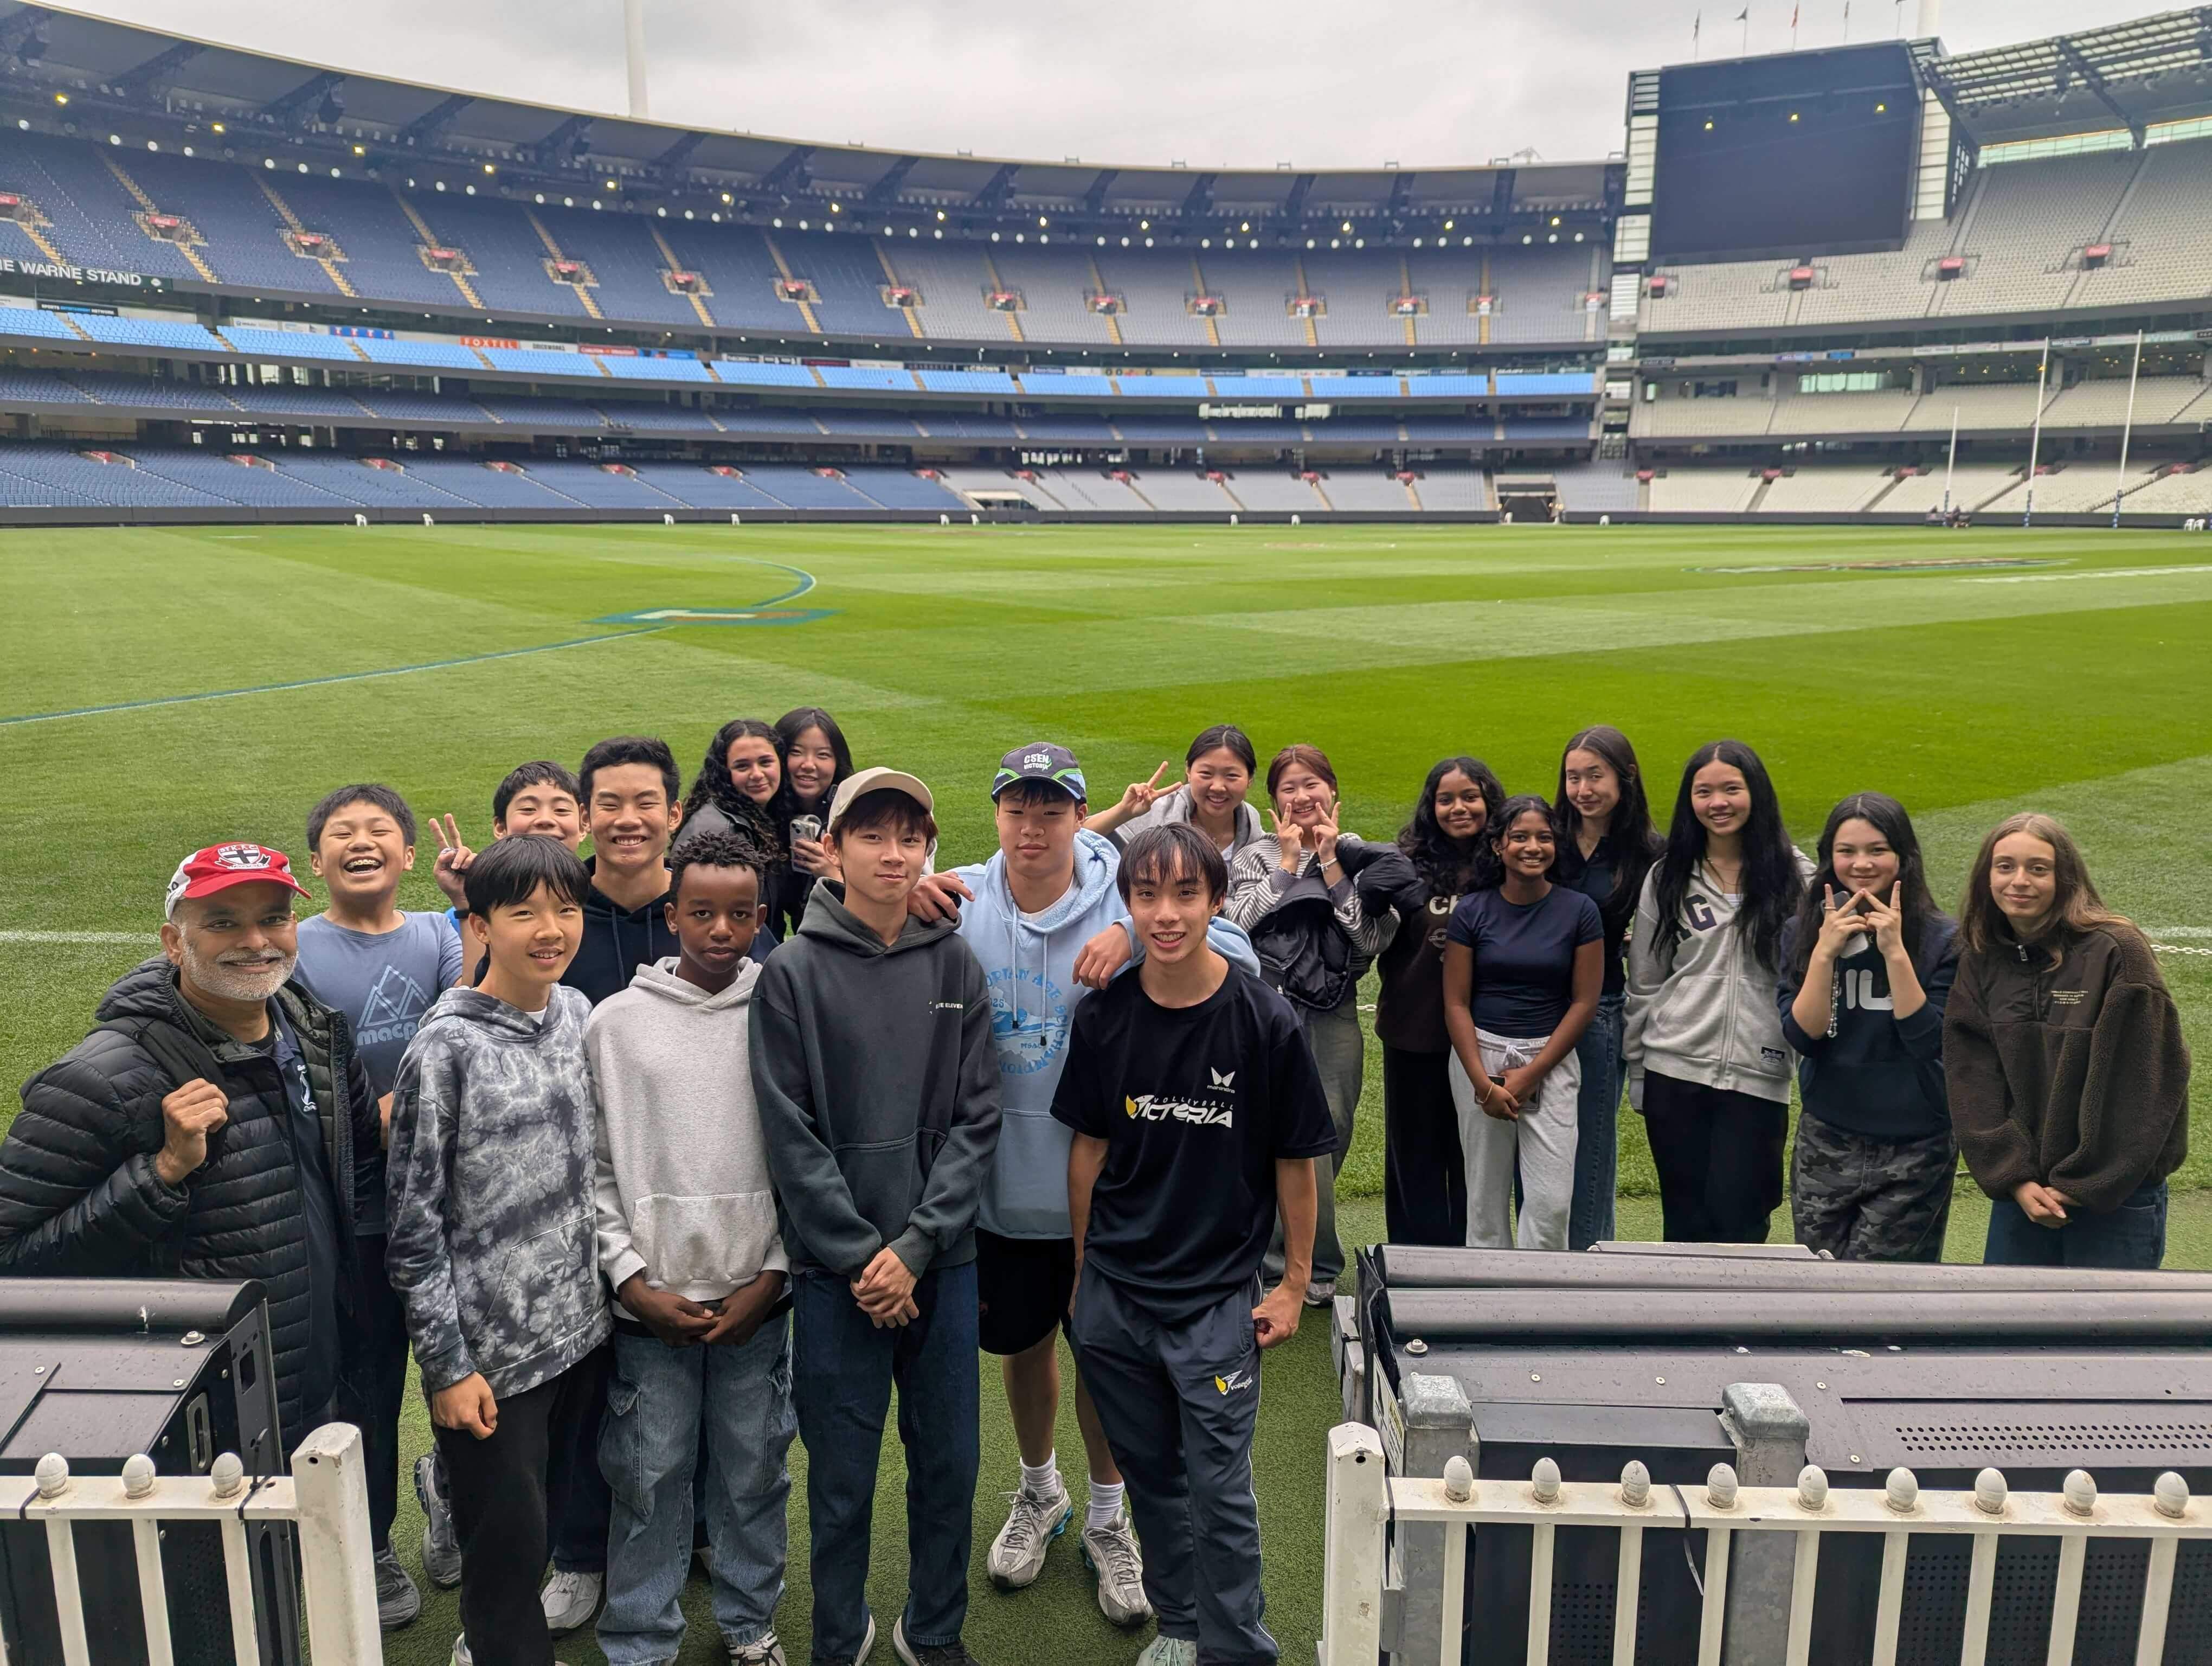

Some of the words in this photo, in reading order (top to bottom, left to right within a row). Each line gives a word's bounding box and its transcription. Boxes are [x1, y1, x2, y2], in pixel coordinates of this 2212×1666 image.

[18, 260, 82, 280] WARNE
[87, 269, 142, 286] STAND
[465, 337, 514, 349] FOXTEL
[1024, 753, 1049, 764] CSEN
[1207, 1085, 1236, 1094] mahindra
[1154, 1095, 1234, 1110] VOLLEYBALL
